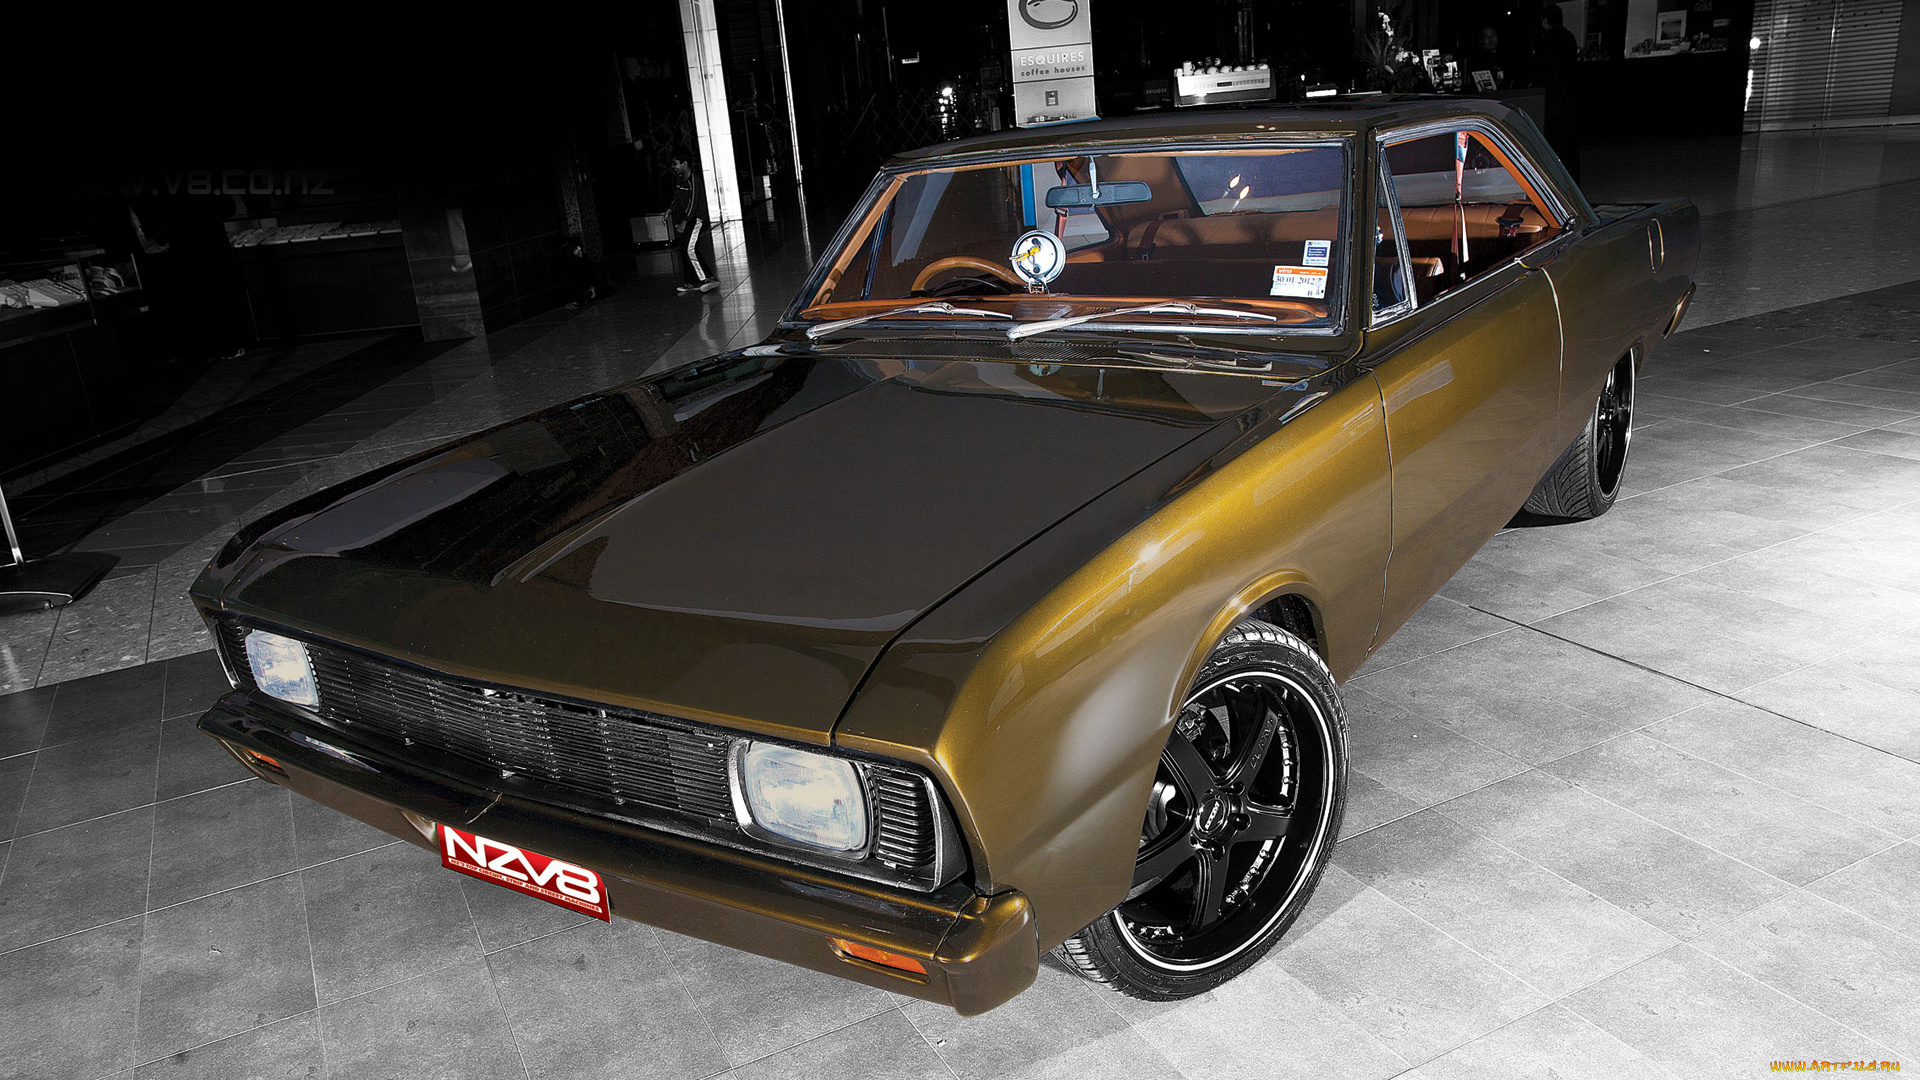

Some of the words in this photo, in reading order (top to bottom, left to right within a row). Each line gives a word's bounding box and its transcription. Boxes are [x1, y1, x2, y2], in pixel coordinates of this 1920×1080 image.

[1020, 51, 1085, 66] ESQUIRES
[1021, 68, 1050, 77] coffee
[1054, 65, 1085, 74] houses
[443, 825, 601, 904] NZV8
[466, 863, 479, 871] TOP
[478, 868, 505, 881] CIRCUIT,
[506, 876, 524, 886] STRIP
[525, 883, 540, 892] AND
[540, 888, 563, 899] STREET
[564, 896, 600, 912] MACHINES
